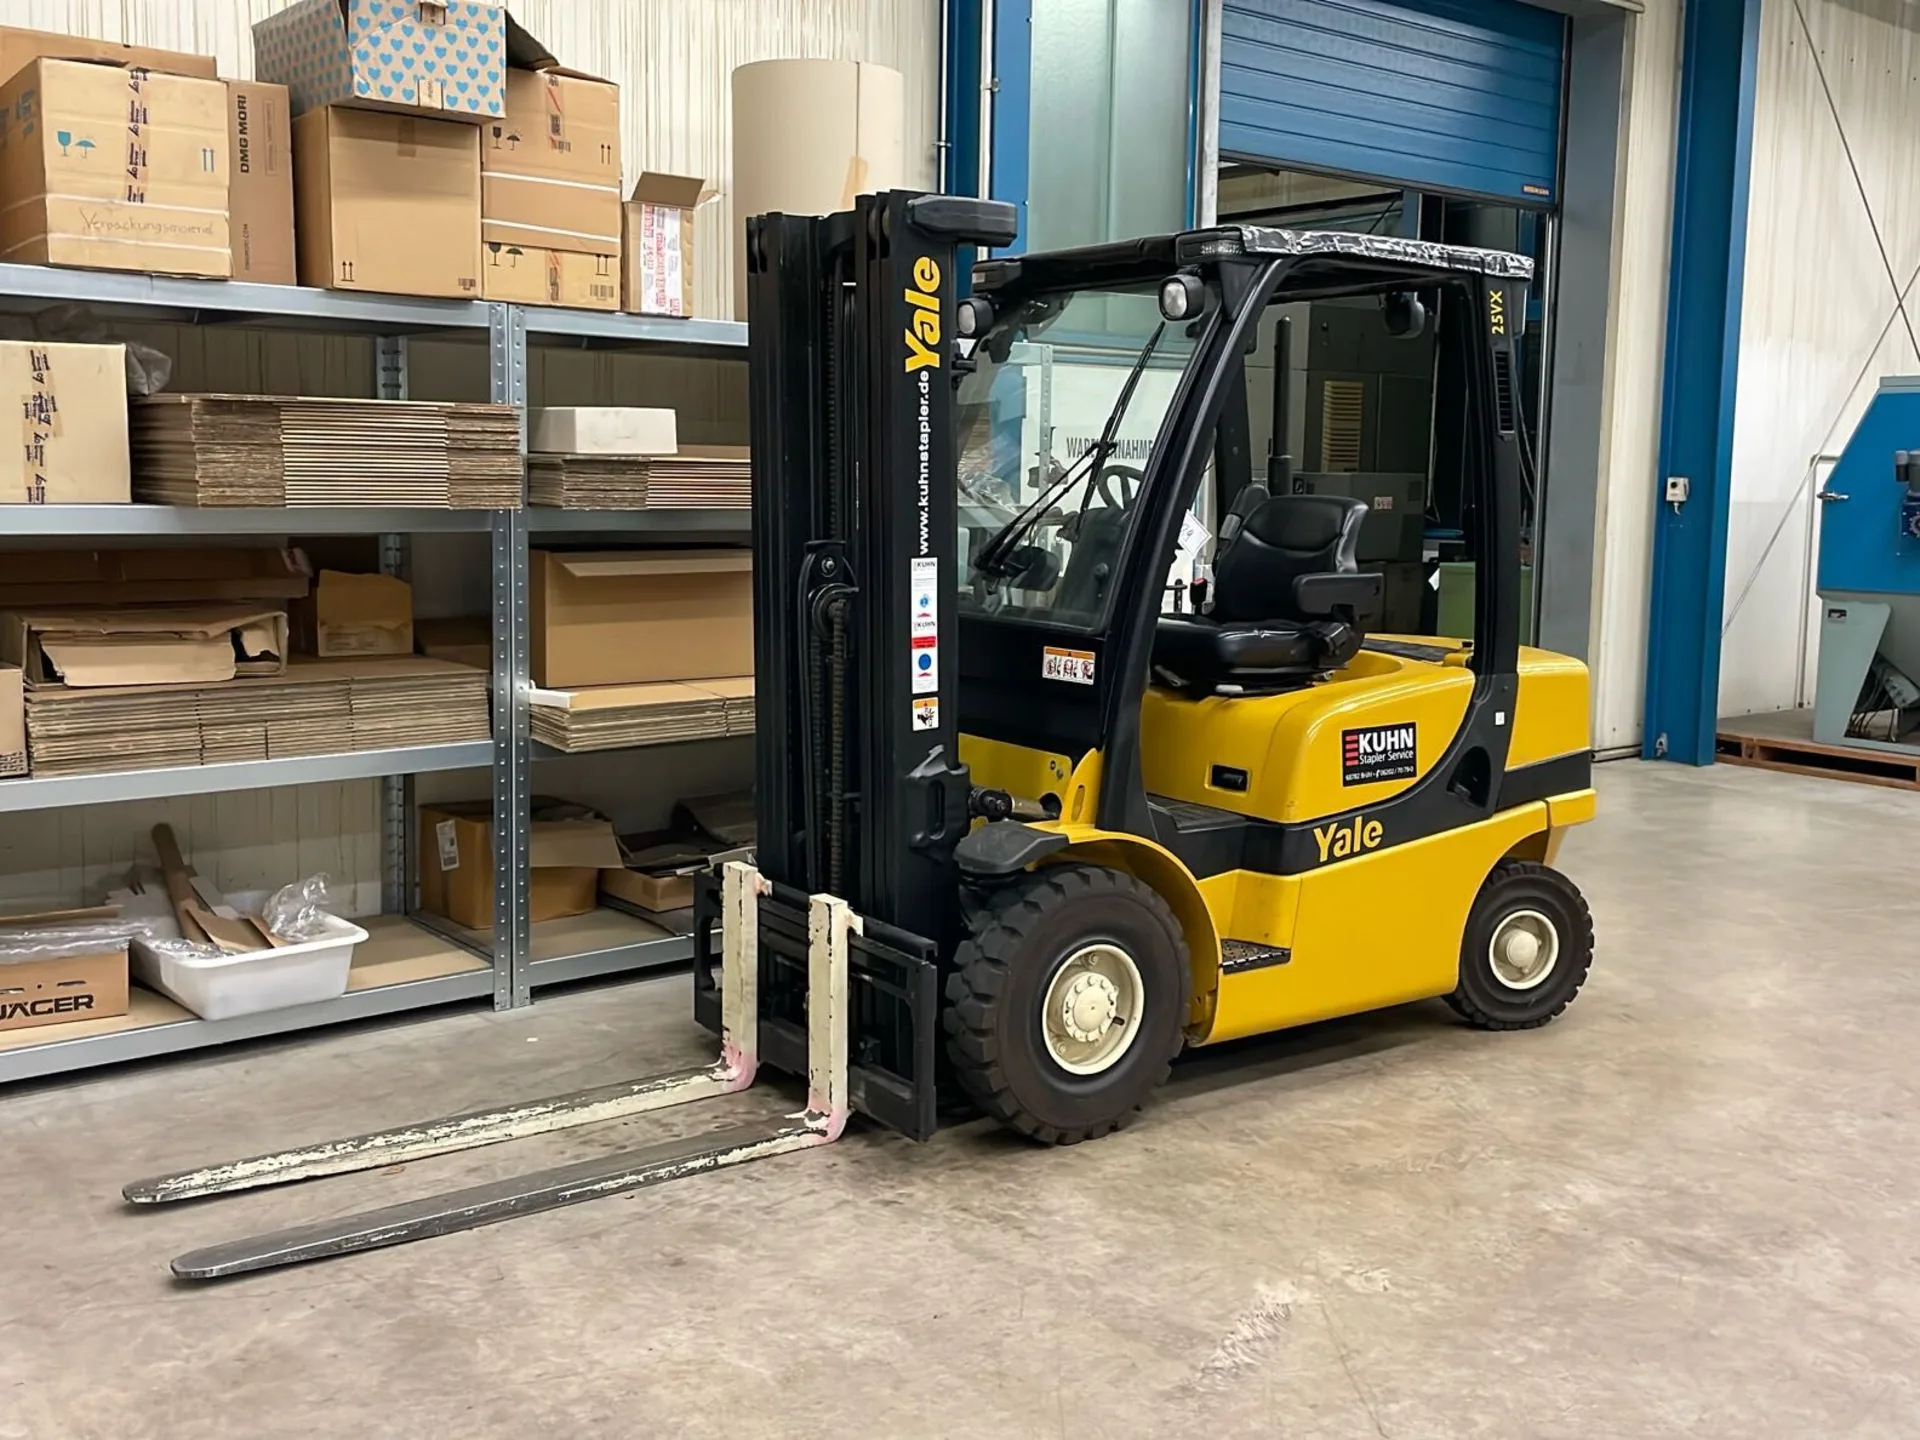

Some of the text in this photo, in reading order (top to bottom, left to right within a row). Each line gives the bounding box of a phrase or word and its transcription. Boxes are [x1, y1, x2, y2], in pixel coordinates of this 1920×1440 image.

[237, 94, 250, 174] DMG MORI
[904, 256, 941, 373] Yale
[1489, 290, 1505, 335] 25VX
[916, 370, 931, 555] www.kuhnstapler.de
[1359, 728, 1413, 753] KUHN
[1359, 750, 1414, 765] Stapler Service
[1313, 816, 1383, 862] Yale
